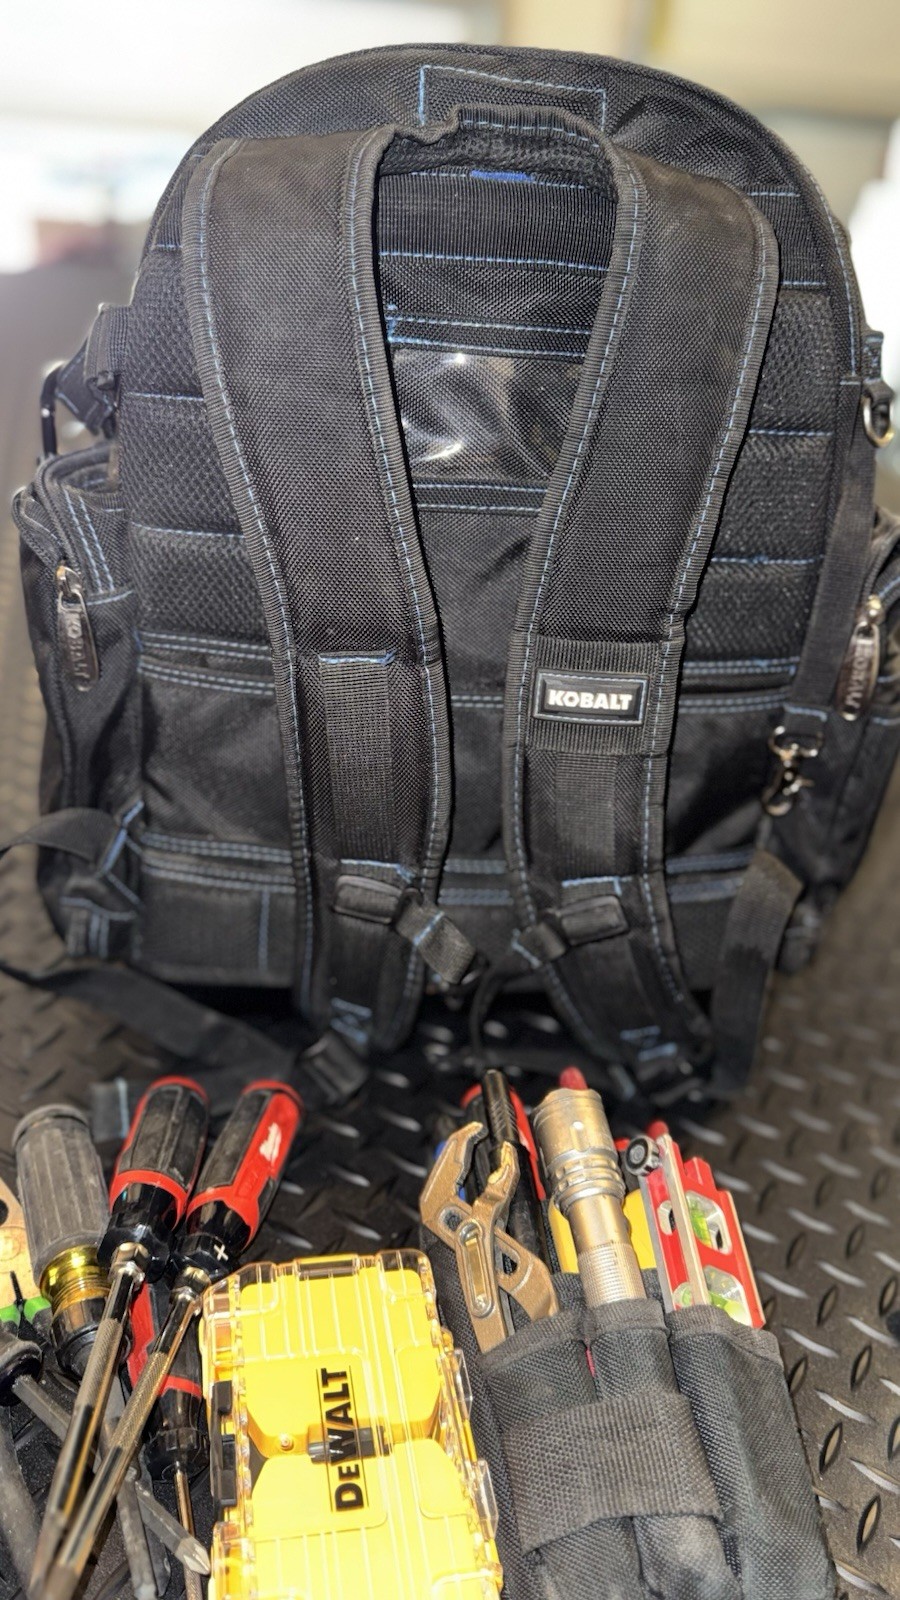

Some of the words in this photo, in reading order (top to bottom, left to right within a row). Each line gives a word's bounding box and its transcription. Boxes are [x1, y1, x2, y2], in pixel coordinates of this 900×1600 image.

[67, 613, 90, 679] KOBALT
[547, 689, 633, 711] KOBALT
[320, 1367, 364, 1511] DEWALT
